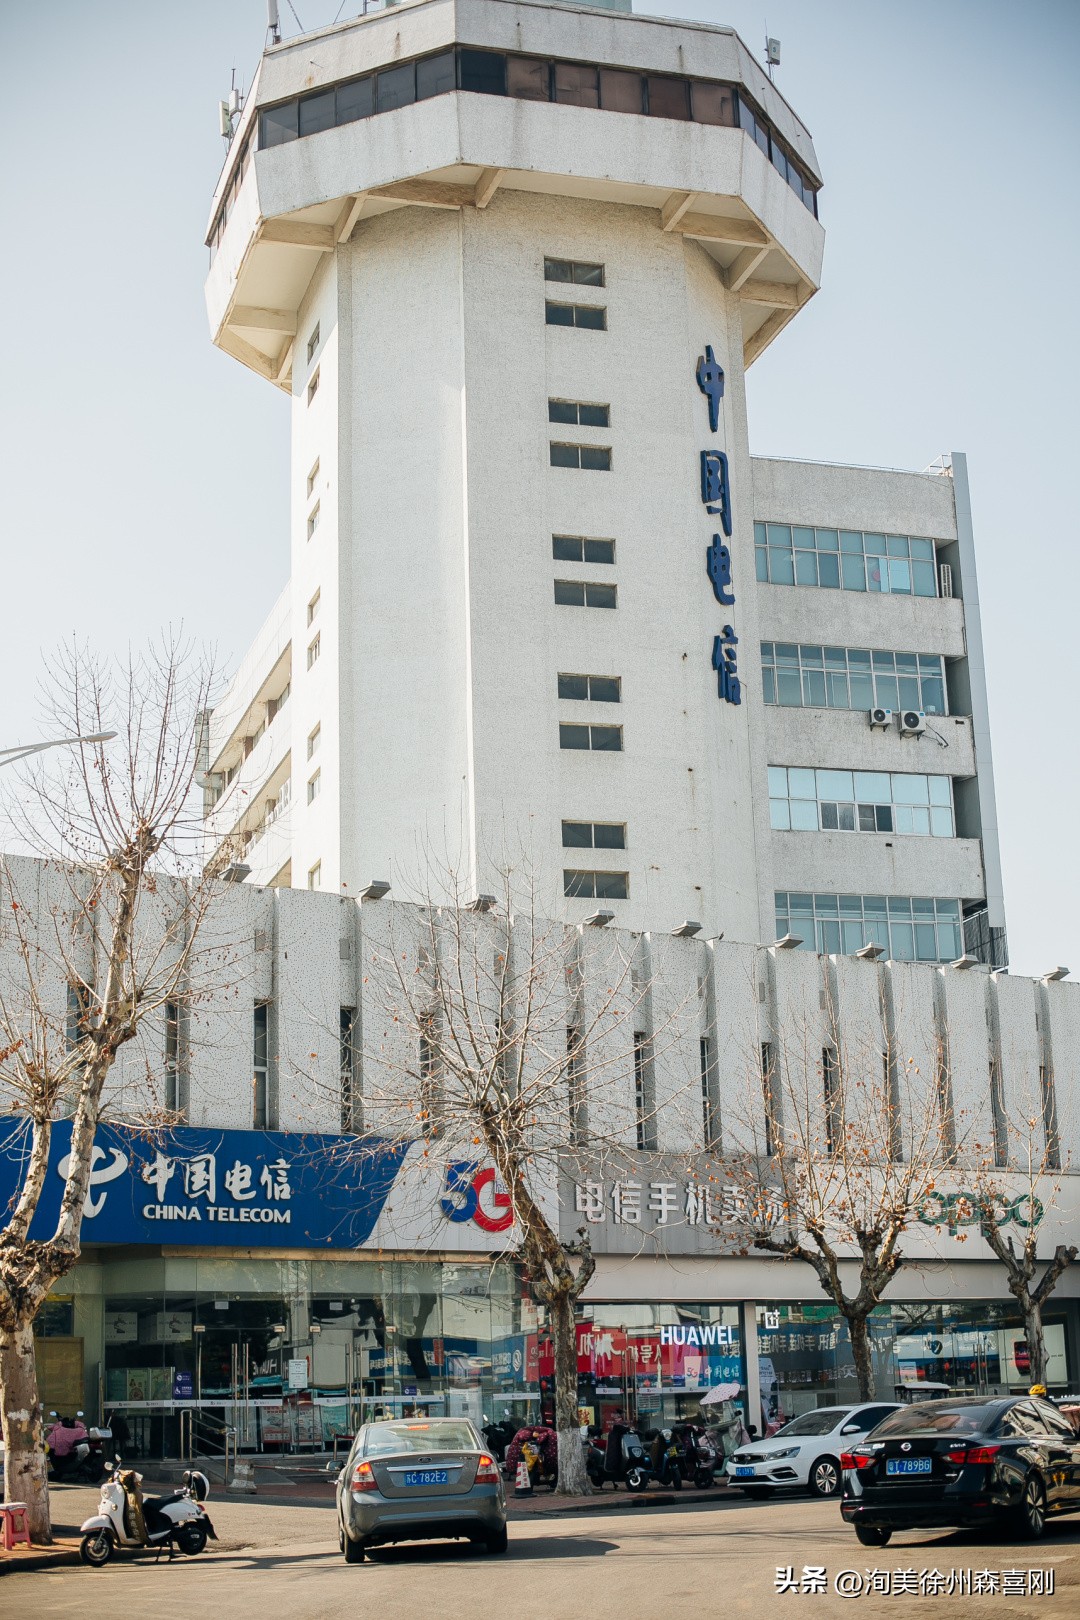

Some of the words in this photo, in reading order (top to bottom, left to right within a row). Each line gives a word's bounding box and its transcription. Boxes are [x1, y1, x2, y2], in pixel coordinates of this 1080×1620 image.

[695, 344, 741, 706] 中国电信
[142, 1150, 292, 1204] 中国电信
[441, 1159, 514, 1233] 5G
[143, 1204, 201, 1221] CHINA
[206, 1206, 291, 1224] TELECOM
[660, 1325, 733, 1346] HUAWEI
